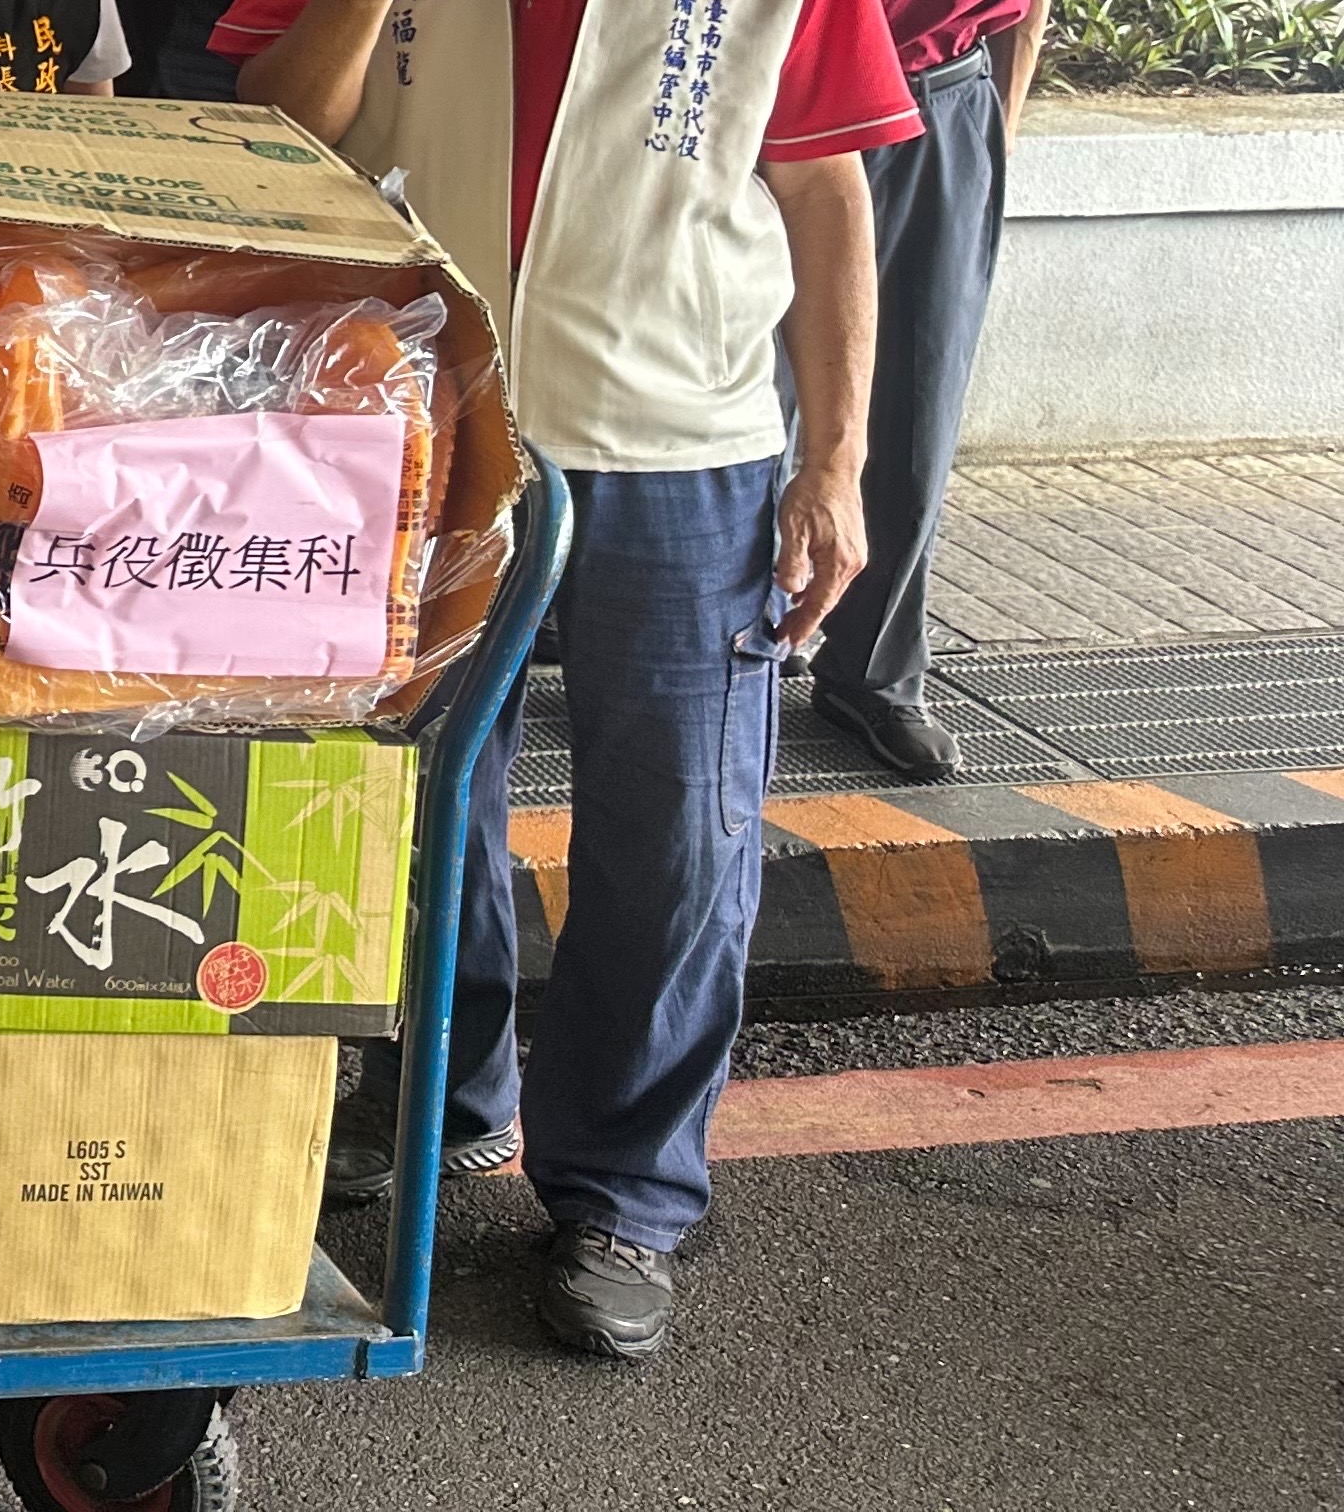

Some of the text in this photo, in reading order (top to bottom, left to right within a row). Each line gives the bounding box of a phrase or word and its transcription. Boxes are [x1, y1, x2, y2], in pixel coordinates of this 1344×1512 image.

[32, 15, 63, 94] 民政
[29, 531, 360, 596] 兵役徵集科
[25, 969, 76, 989] Water
[66, 1140, 126, 1160] L605 S
[79, 1162, 111, 1180] SST
[20, 1182, 164, 1203] MADE IN TAIWAN
